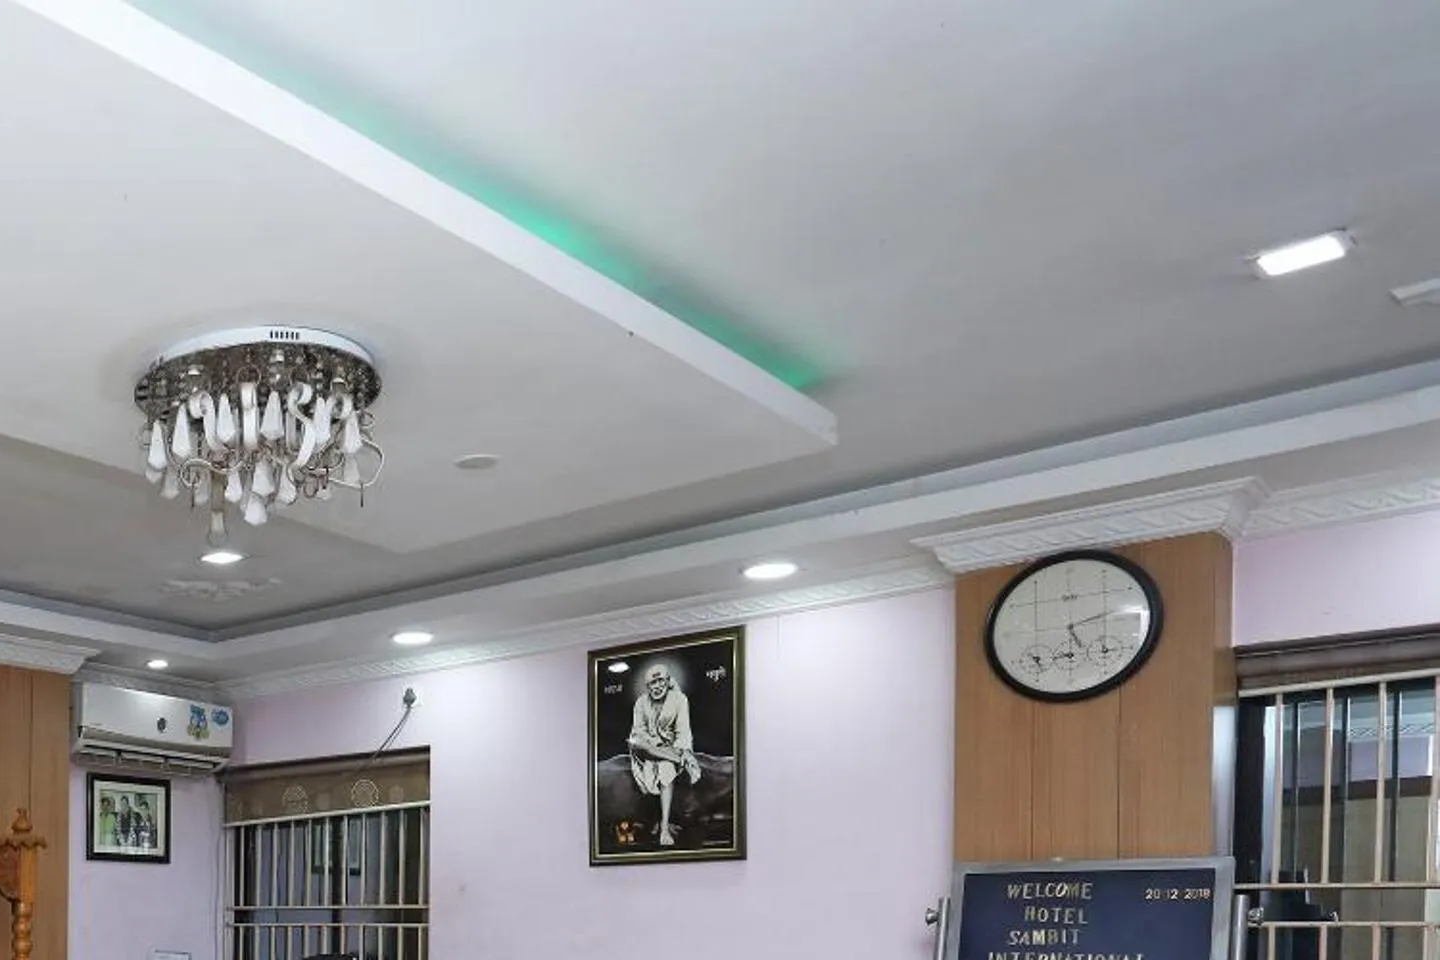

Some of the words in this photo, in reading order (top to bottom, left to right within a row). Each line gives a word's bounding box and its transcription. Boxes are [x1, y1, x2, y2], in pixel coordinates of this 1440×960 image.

[1007, 882, 1094, 900] WELCOME
[1024, 905, 1088, 925] HOTEL
[1008, 928, 1082, 946] SAMBIT
